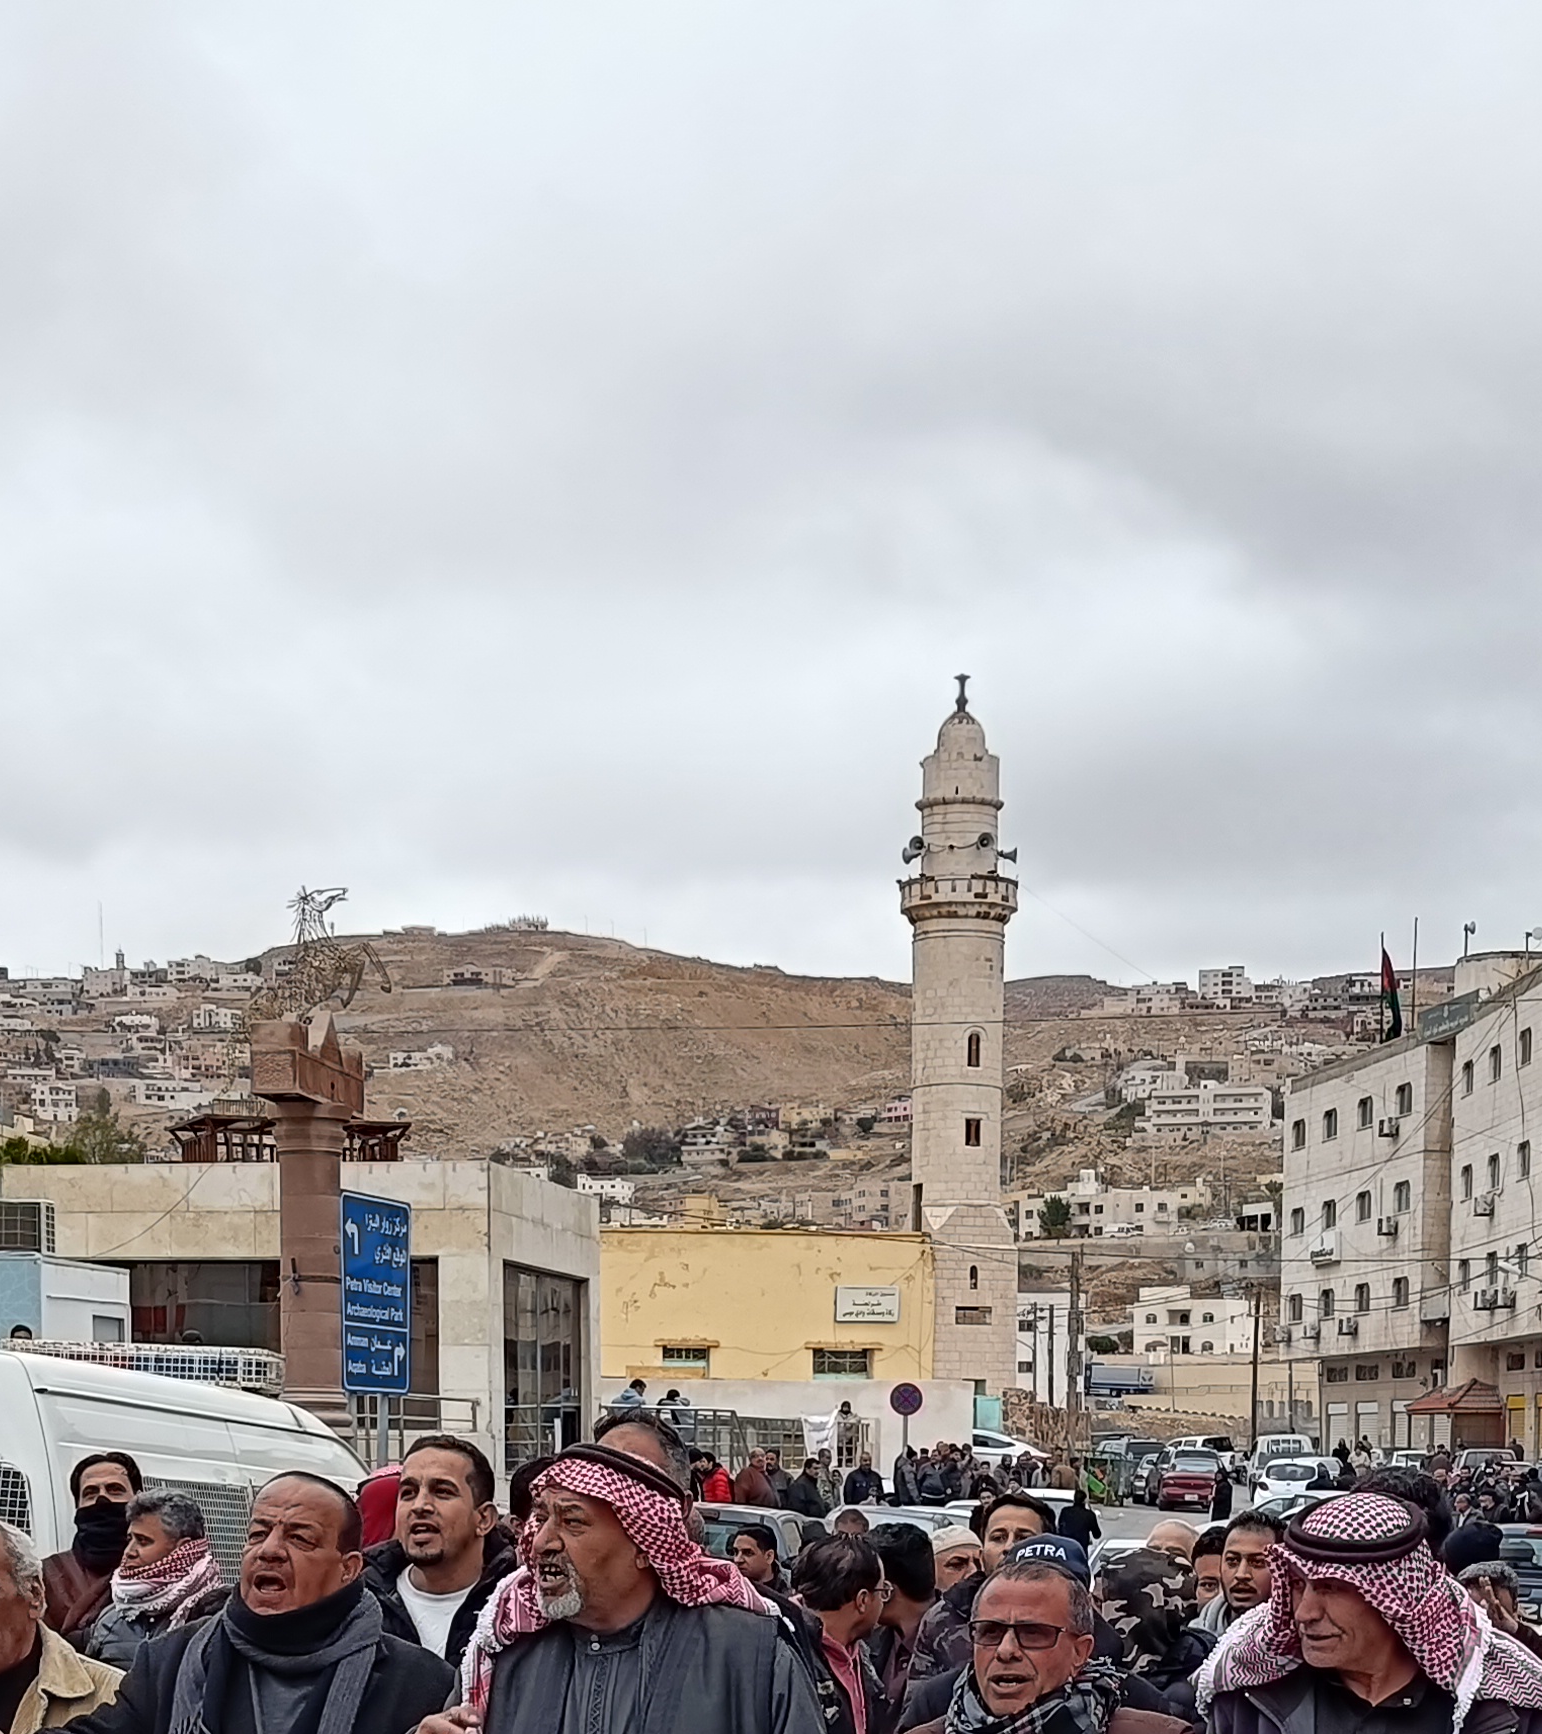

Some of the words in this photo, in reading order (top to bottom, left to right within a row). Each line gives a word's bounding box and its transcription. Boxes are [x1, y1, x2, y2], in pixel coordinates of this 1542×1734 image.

[392, 1216, 407, 1237] مركز
[345, 1276, 363, 1292] Petra
[363, 1278, 382, 1295] Visitor
[383, 1281, 402, 1297] Center
[346, 1301, 390, 1323] Archaeological
[390, 1307, 404, 1322] Park
[346, 1332, 369, 1348] Amman
[370, 1334, 392, 1352] عمان
[347, 1359, 367, 1375] Aqaba
[1015, 1543, 1068, 1562] PETRA
